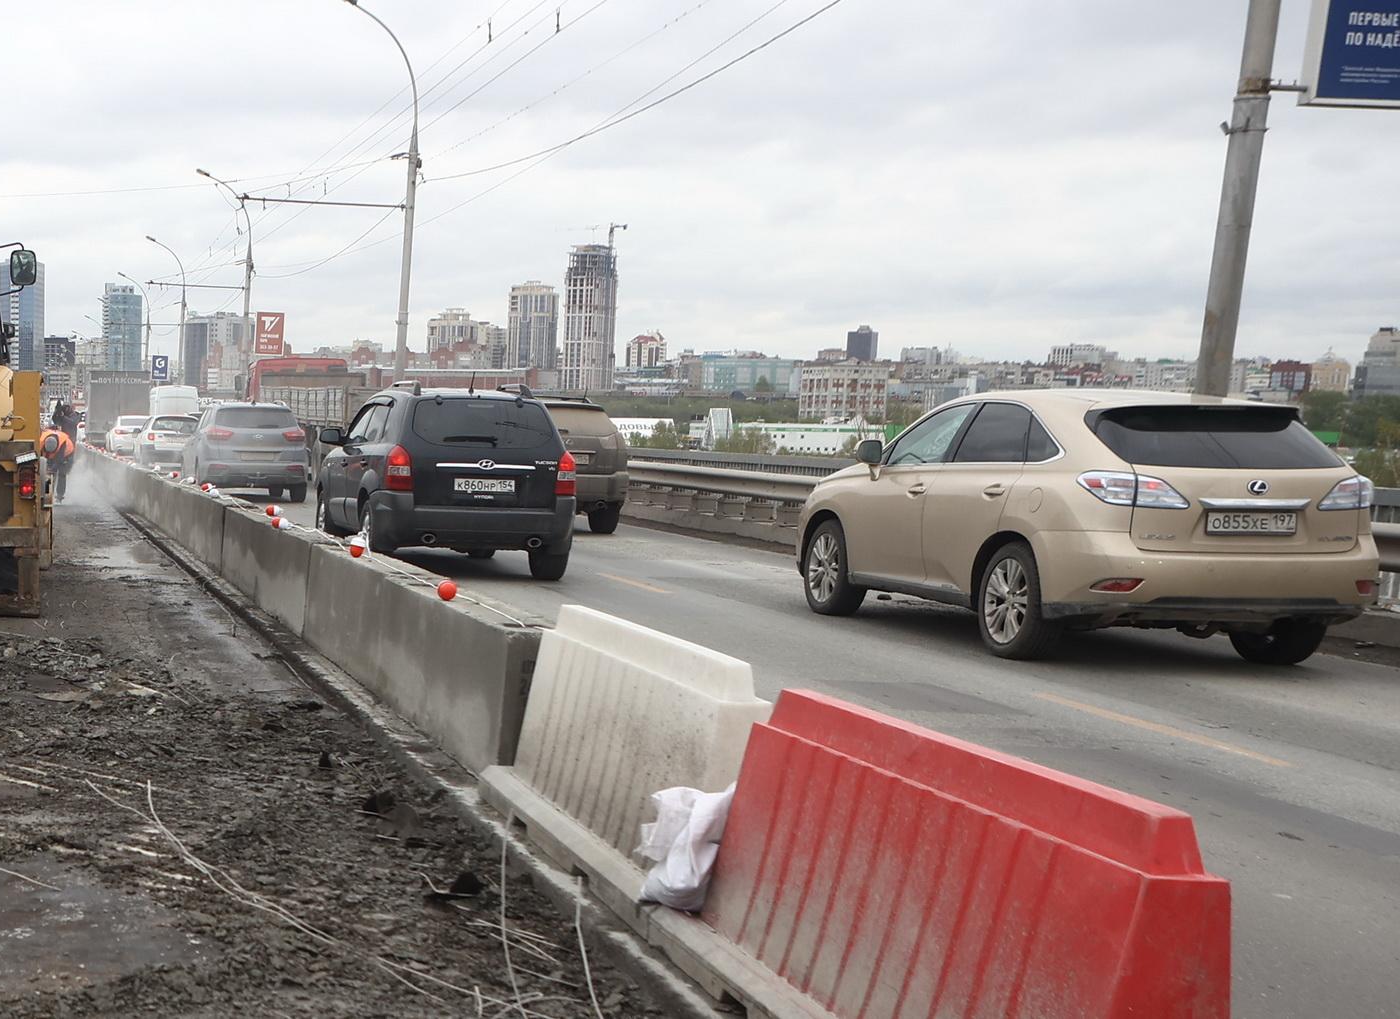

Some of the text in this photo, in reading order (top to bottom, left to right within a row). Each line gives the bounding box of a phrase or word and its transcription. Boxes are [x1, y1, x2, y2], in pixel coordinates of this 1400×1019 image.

[1348, 12, 1400, 26] ПЕРВЫЕ
[1345, 32, 1363, 45] ПО
[619, 423, 656, 431] ДОВЫ
[497, 481, 513, 489] 154
[1272, 514, 1294, 526] 197
